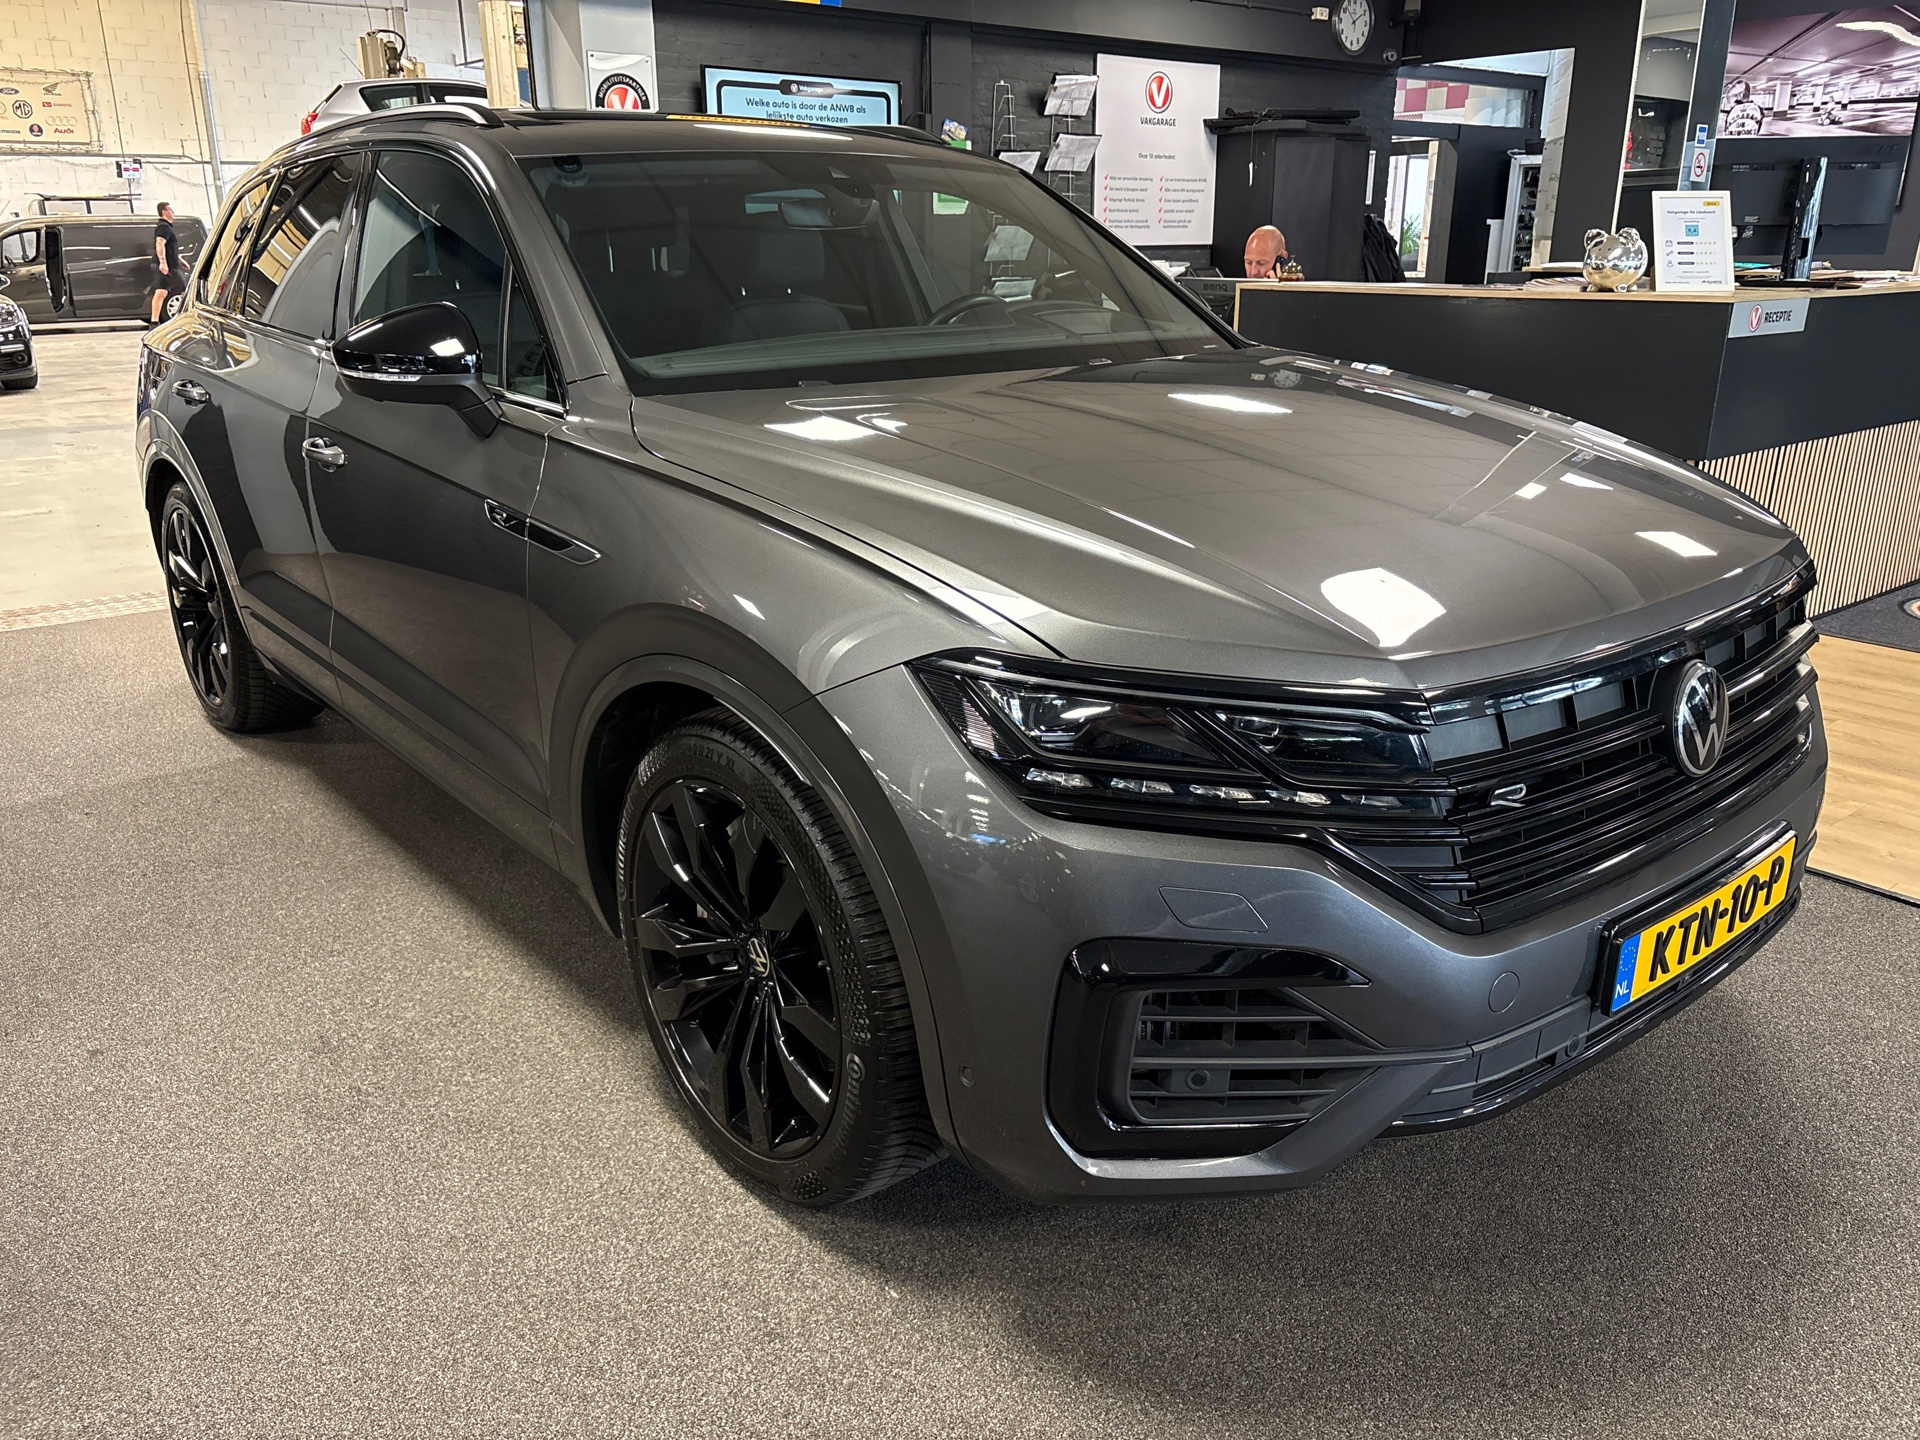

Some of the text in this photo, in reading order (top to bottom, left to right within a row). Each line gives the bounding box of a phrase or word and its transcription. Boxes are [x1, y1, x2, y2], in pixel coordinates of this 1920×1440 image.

[597, 75, 647, 101] MOBILITEITSPARTNER
[14, 102, 31, 117] MG
[745, 97, 866, 114] Welke auto is door de ANWB als
[796, 114, 814, 122] auto
[814, 114, 849, 124] verkozen
[1139, 116, 1177, 127] VAKGARAGE
[1203, 283, 1229, 292] BenQ
[1763, 310, 1793, 324] RECEPTIE
[724, 755, 736, 773] XL
[1648, 854, 1786, 983] KTN-10-P
[1614, 979, 1630, 999] NL
